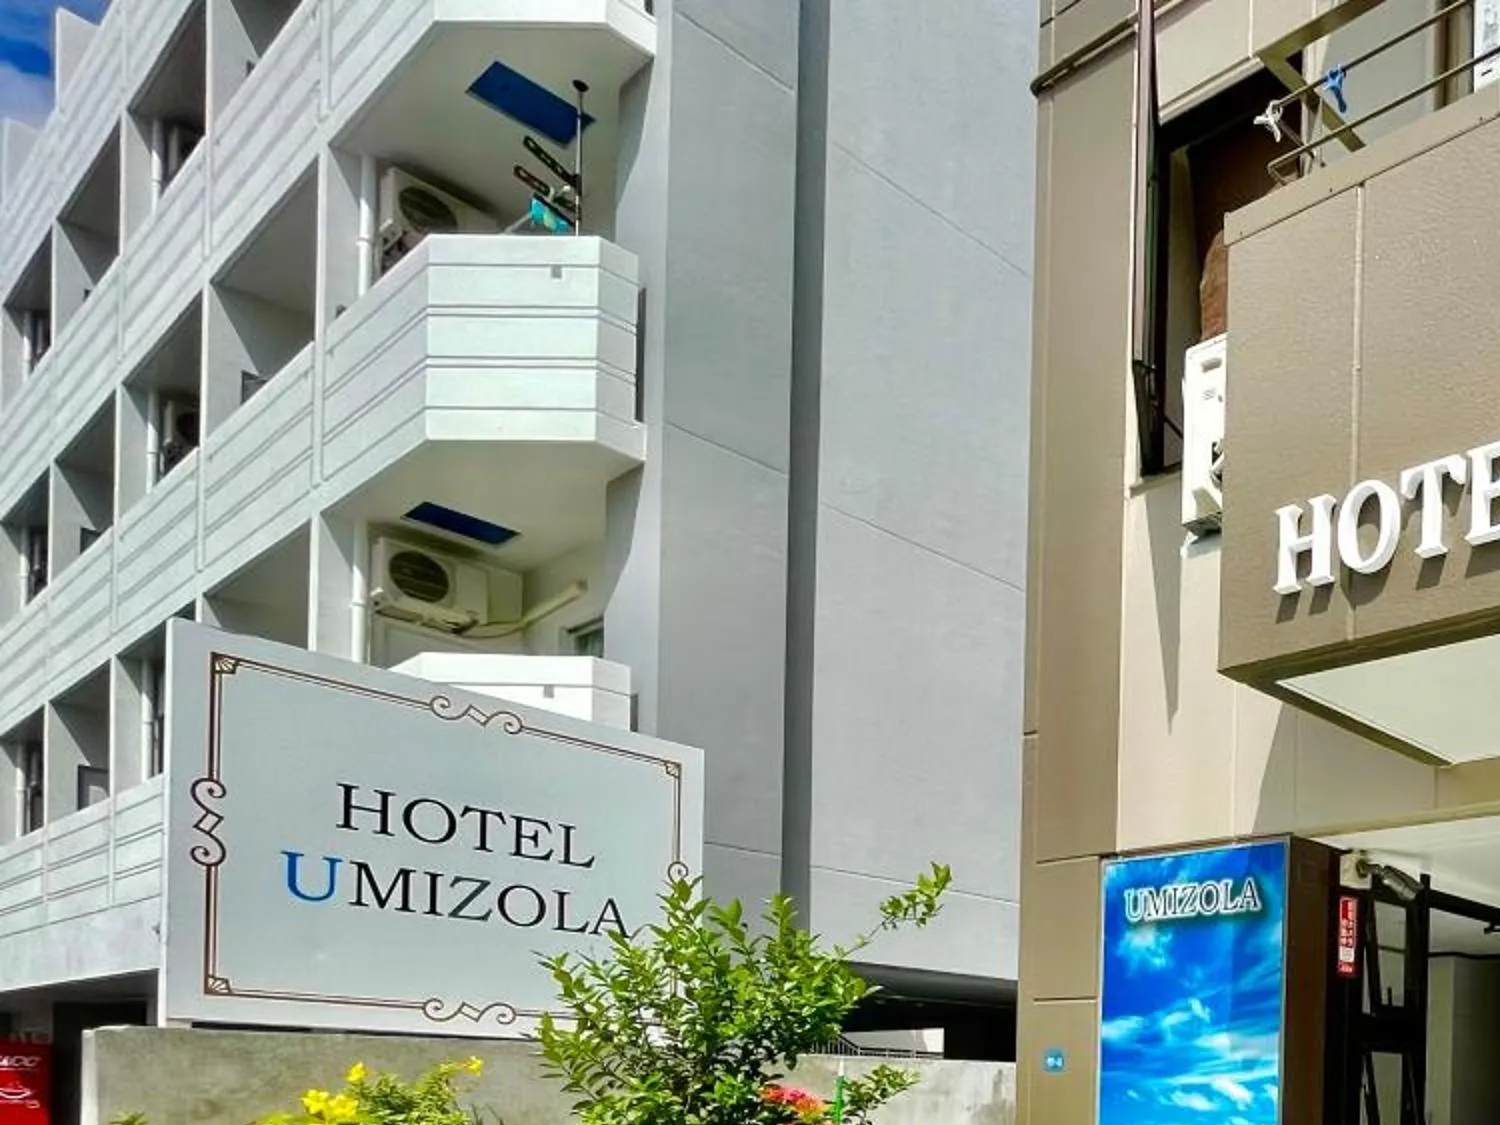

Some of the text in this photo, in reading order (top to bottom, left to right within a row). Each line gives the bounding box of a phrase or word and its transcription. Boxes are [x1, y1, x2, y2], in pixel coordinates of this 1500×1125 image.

[335, 782, 596, 869] HOTEL
[280, 850, 632, 939] UMIZOLA
[1123, 877, 1263, 923] UMIZOLA
